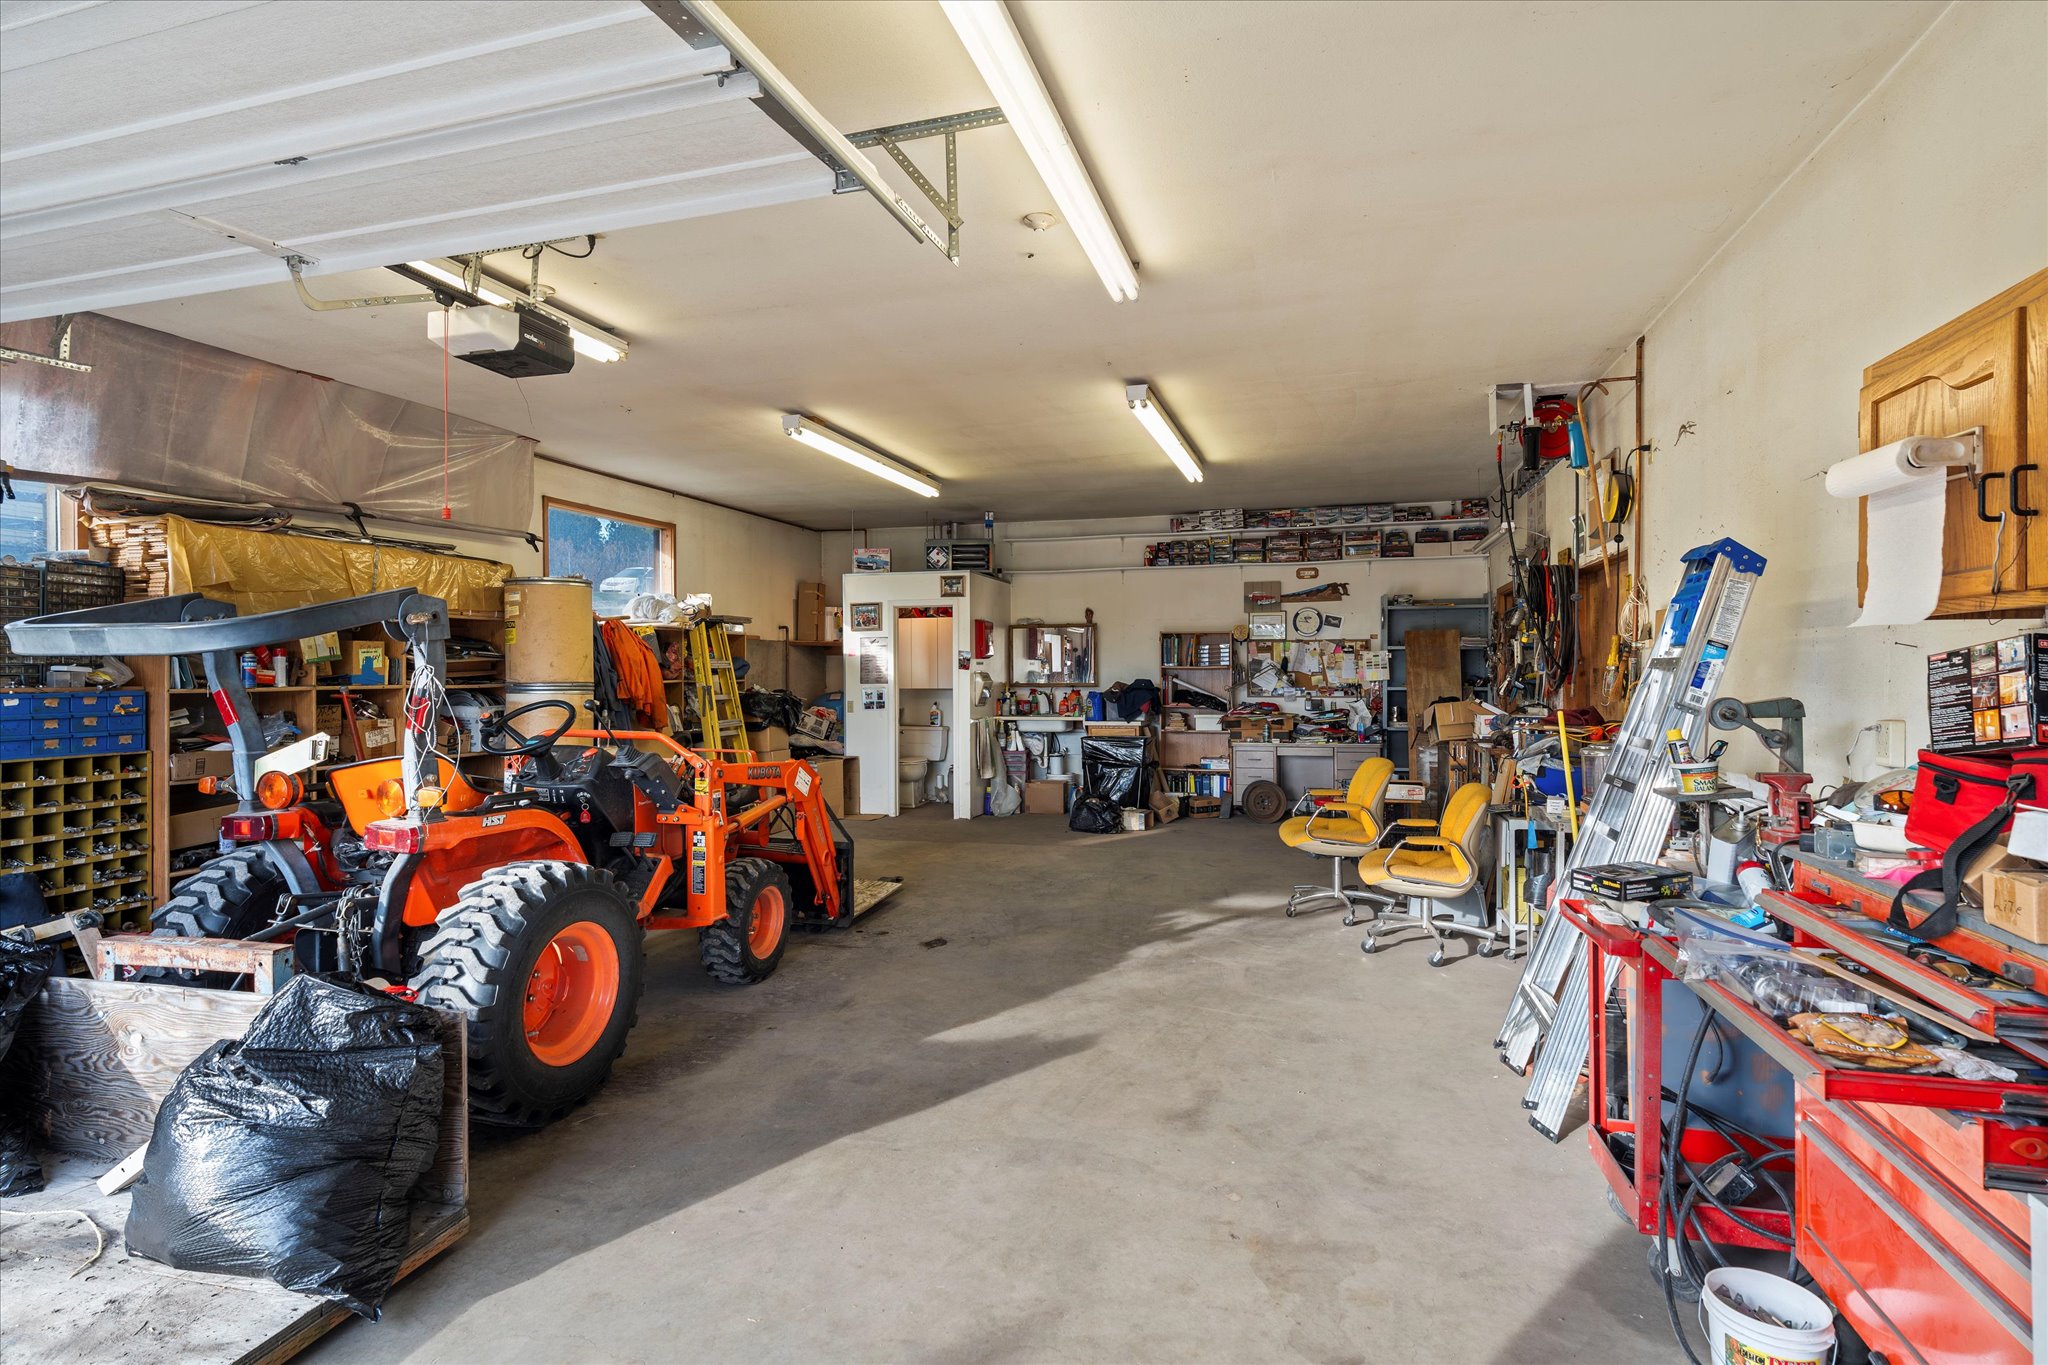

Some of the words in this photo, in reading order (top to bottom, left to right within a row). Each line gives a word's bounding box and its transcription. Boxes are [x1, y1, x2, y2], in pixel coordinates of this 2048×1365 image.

[746, 765, 782, 780] KUBOTA
[482, 814, 506, 829] HST
[1823, 1038, 1864, 1053] SALTED
